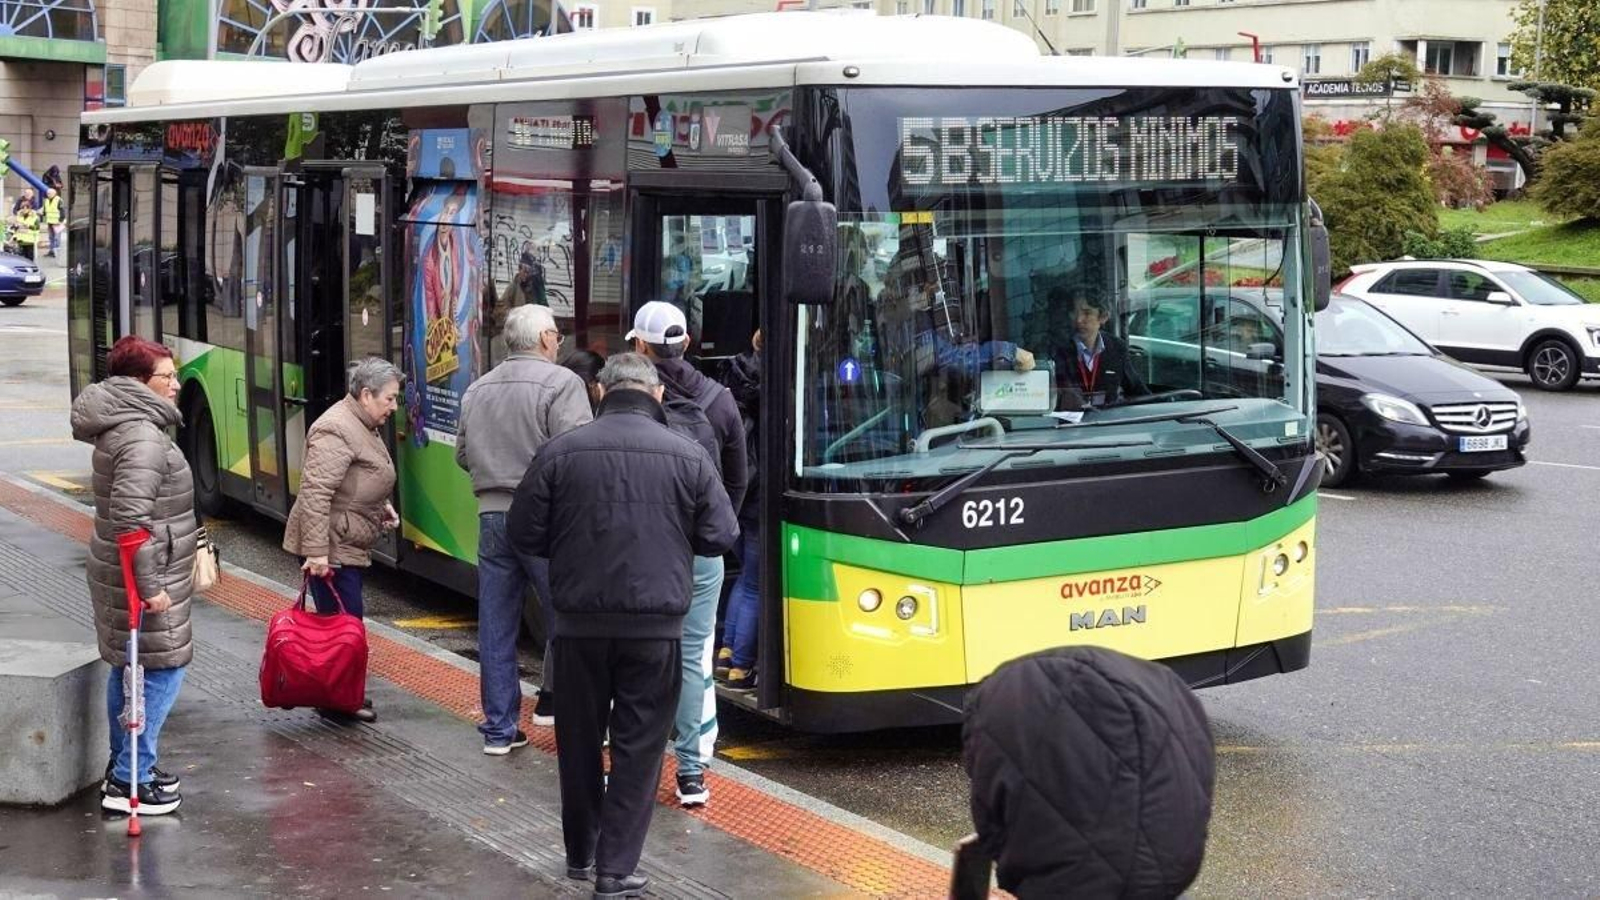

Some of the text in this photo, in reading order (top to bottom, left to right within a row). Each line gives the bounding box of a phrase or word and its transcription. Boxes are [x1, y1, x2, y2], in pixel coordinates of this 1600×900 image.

[1308, 83, 1349, 94] ACADEMIA
[1352, 83, 1384, 93] TECNOS
[976, 116, 1120, 183] SERVIZOS
[1130, 116, 1238, 182] MINIMOS
[962, 496, 1025, 529] 6212
[1060, 574, 1141, 599] avanza
[1069, 604, 1147, 632] MAN
